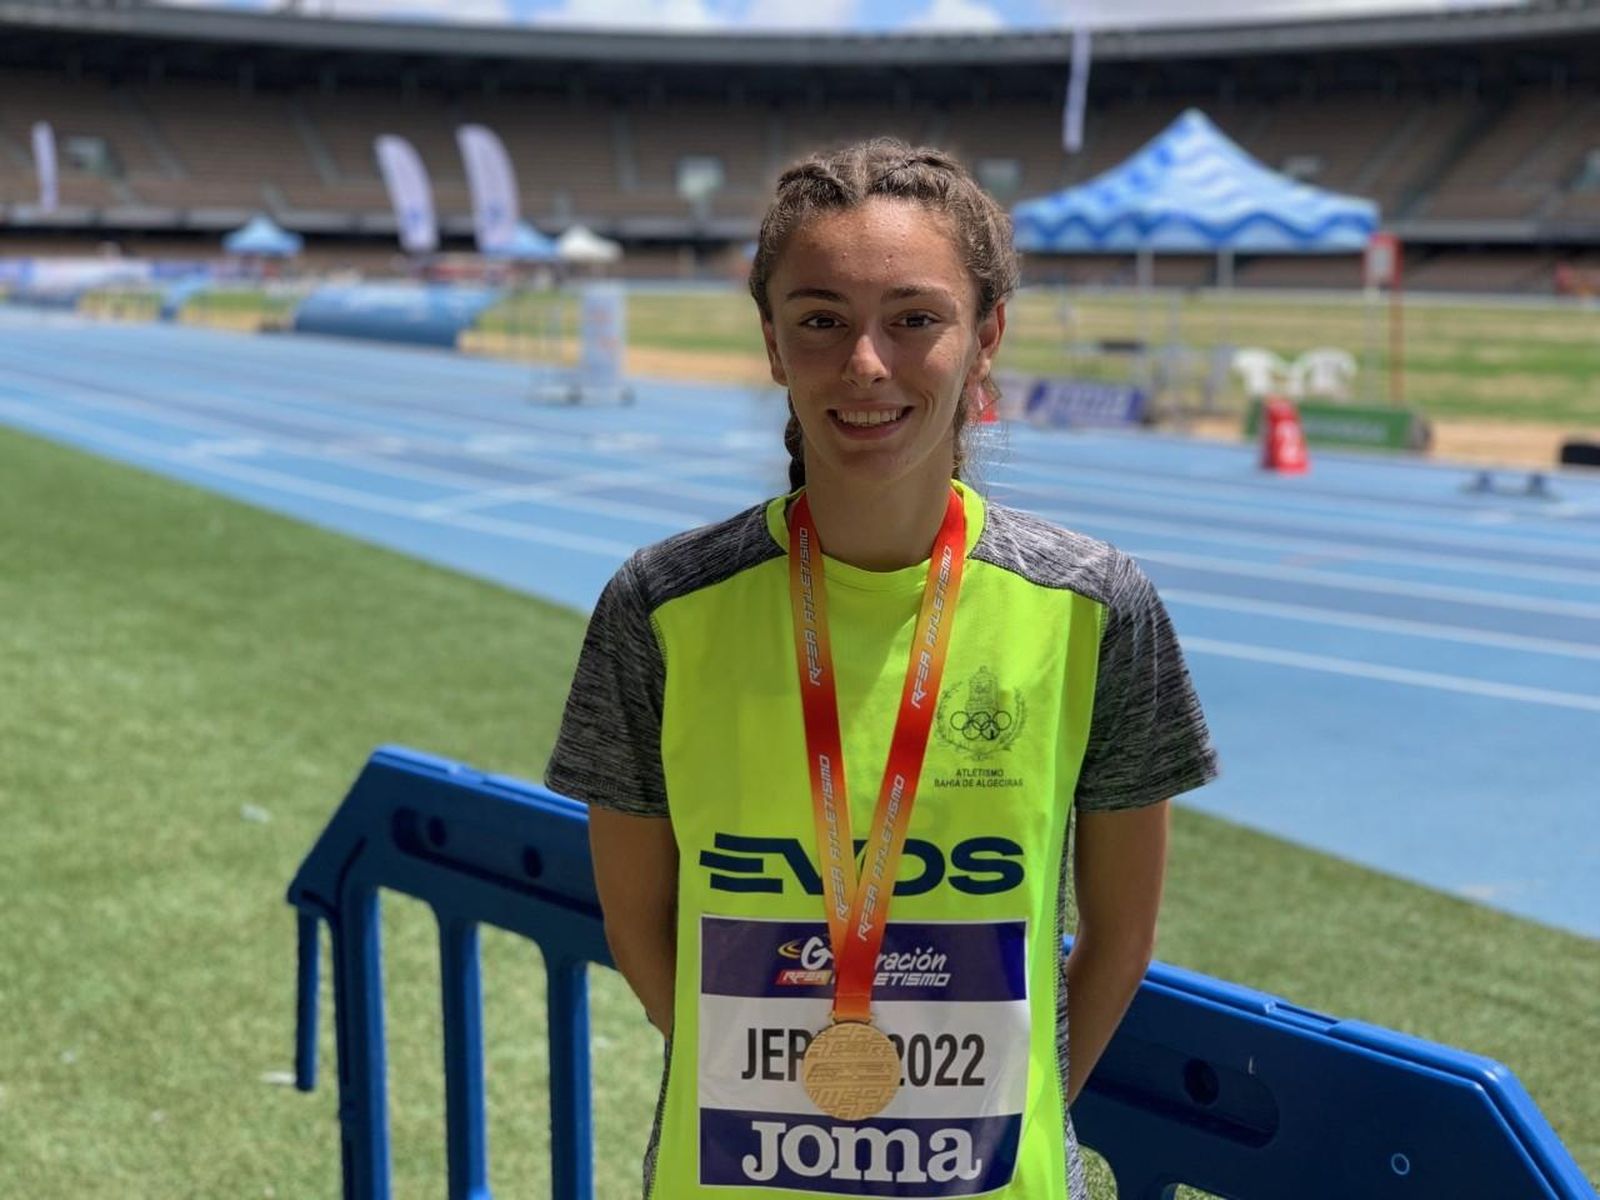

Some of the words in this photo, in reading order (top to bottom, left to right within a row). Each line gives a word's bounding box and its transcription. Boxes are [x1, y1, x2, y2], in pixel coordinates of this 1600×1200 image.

[799, 527, 816, 623] ATLETISMO
[926, 545, 952, 647] ATLETISMO
[956, 768, 1004, 777] ATLETISMO
[963, 779, 974, 787] DE
[976, 779, 1023, 788] ALGECIRAS
[819, 754, 841, 860] ATLETISMO
[873, 773, 905, 880] ATLETISMO
[699, 832, 1025, 897] EVOS
[801, 935, 948, 971] Gración
[830, 972, 951, 987] ETISMO
